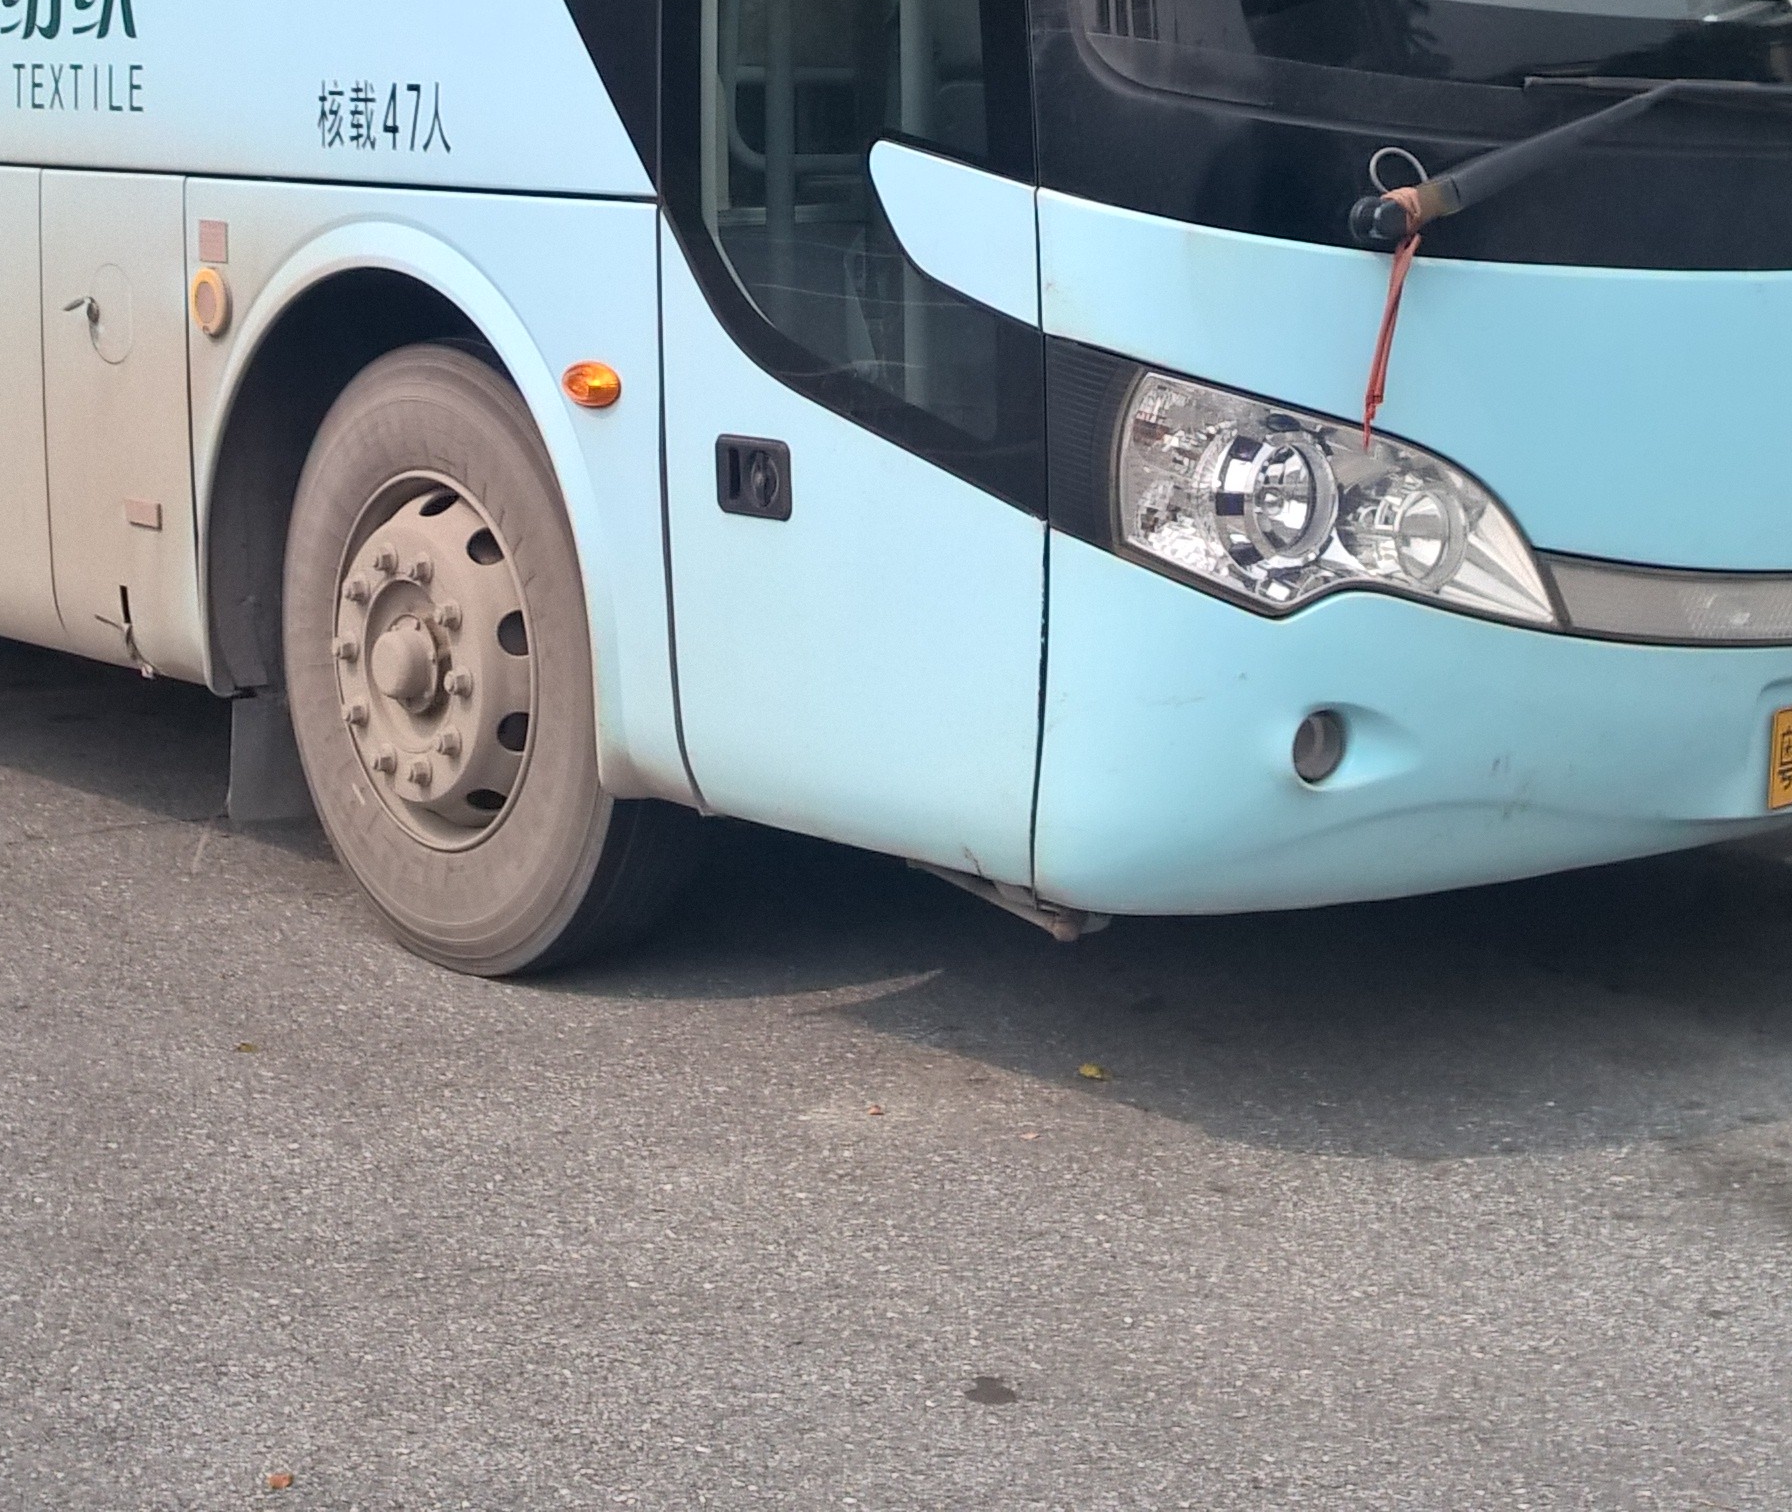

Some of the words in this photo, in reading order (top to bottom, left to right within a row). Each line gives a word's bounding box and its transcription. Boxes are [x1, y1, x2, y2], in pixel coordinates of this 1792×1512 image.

[12, 63, 145, 112] TEXTILE
[317, 79, 451, 153] 核载47人
